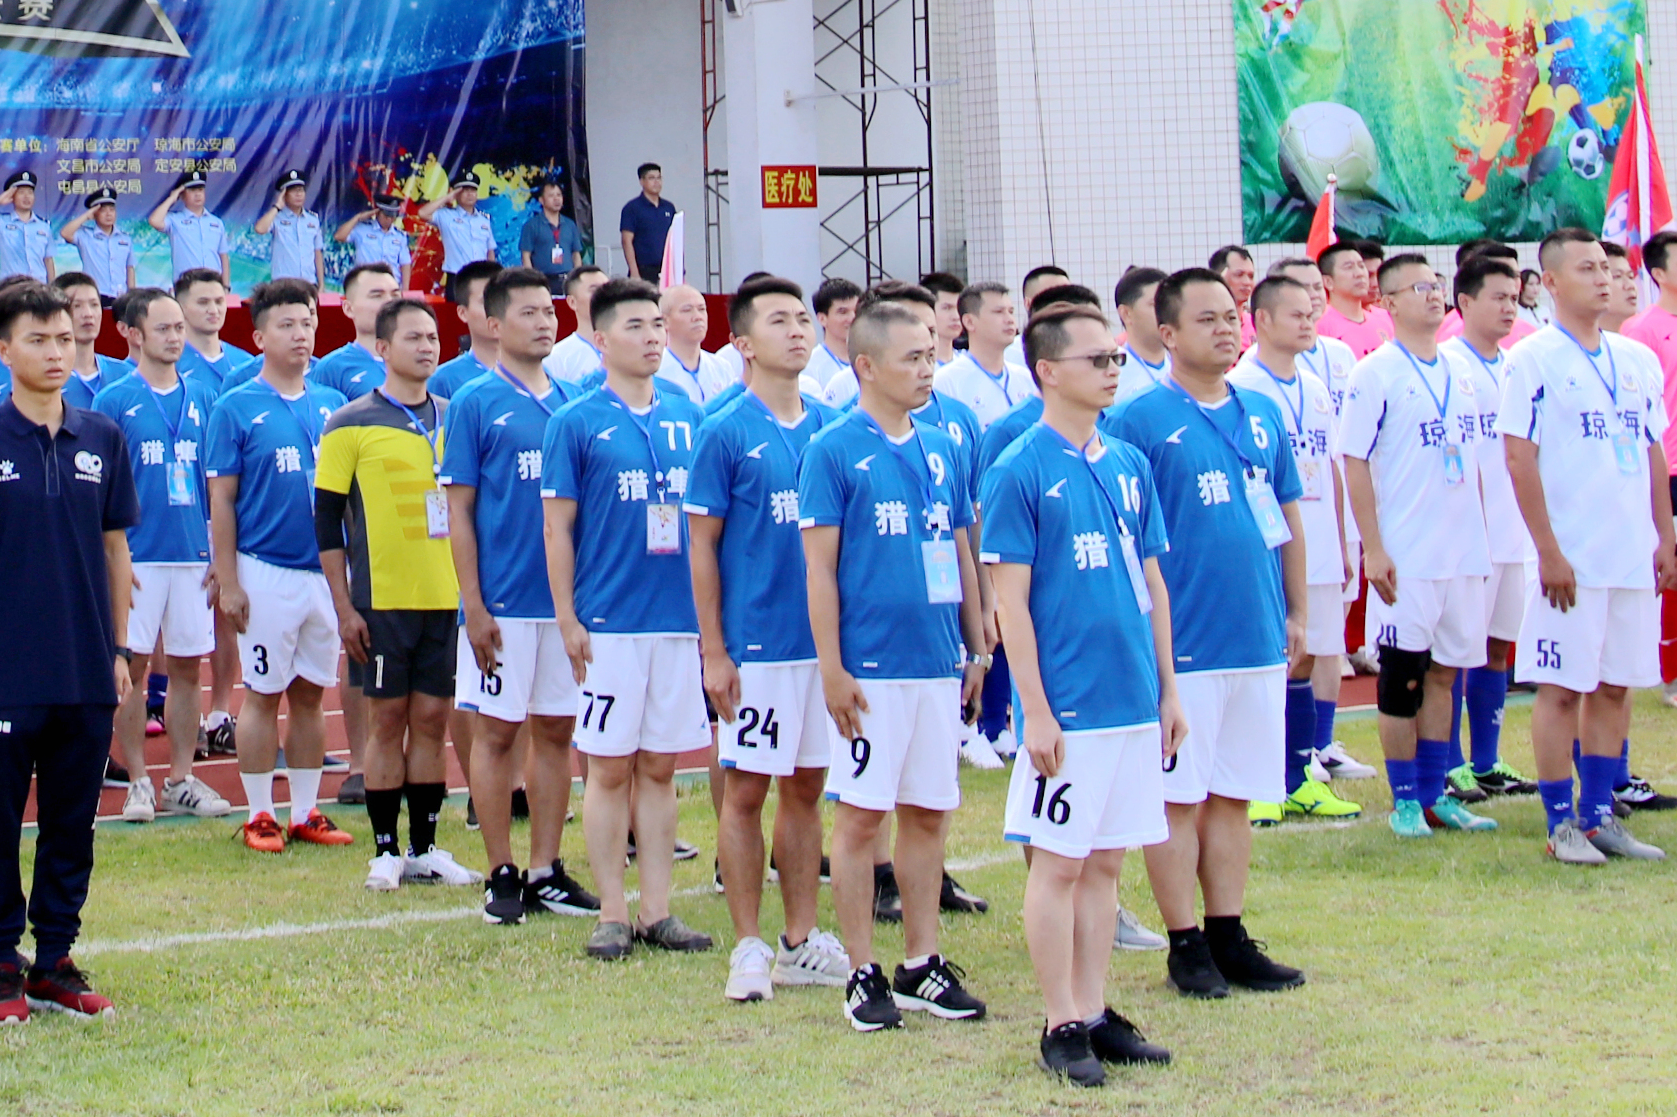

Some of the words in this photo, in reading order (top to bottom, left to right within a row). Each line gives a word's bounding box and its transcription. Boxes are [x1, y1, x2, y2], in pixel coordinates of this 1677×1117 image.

[55, 137, 140, 153] 海南省公安厅
[153, 137, 236, 153] 琼海市公安局
[56, 157, 142, 174] 文昌市公安局
[154, 157, 237, 174] 定安县公安局
[763, 168, 814, 204] 医疗处
[187, 400, 200, 427] 4
[659, 420, 692, 451] 77
[1249, 415, 1269, 449] 5
[928, 452, 945, 486] 9
[1117, 473, 1141, 514] 16
[252, 644, 269, 676] 3
[1535, 639, 1562, 669] 55
[375, 654, 384, 689] 1
[582, 690, 615, 733] 77
[737, 707, 779, 750] 24
[851, 737, 871, 779] 9
[1031, 773, 1073, 826] 16
